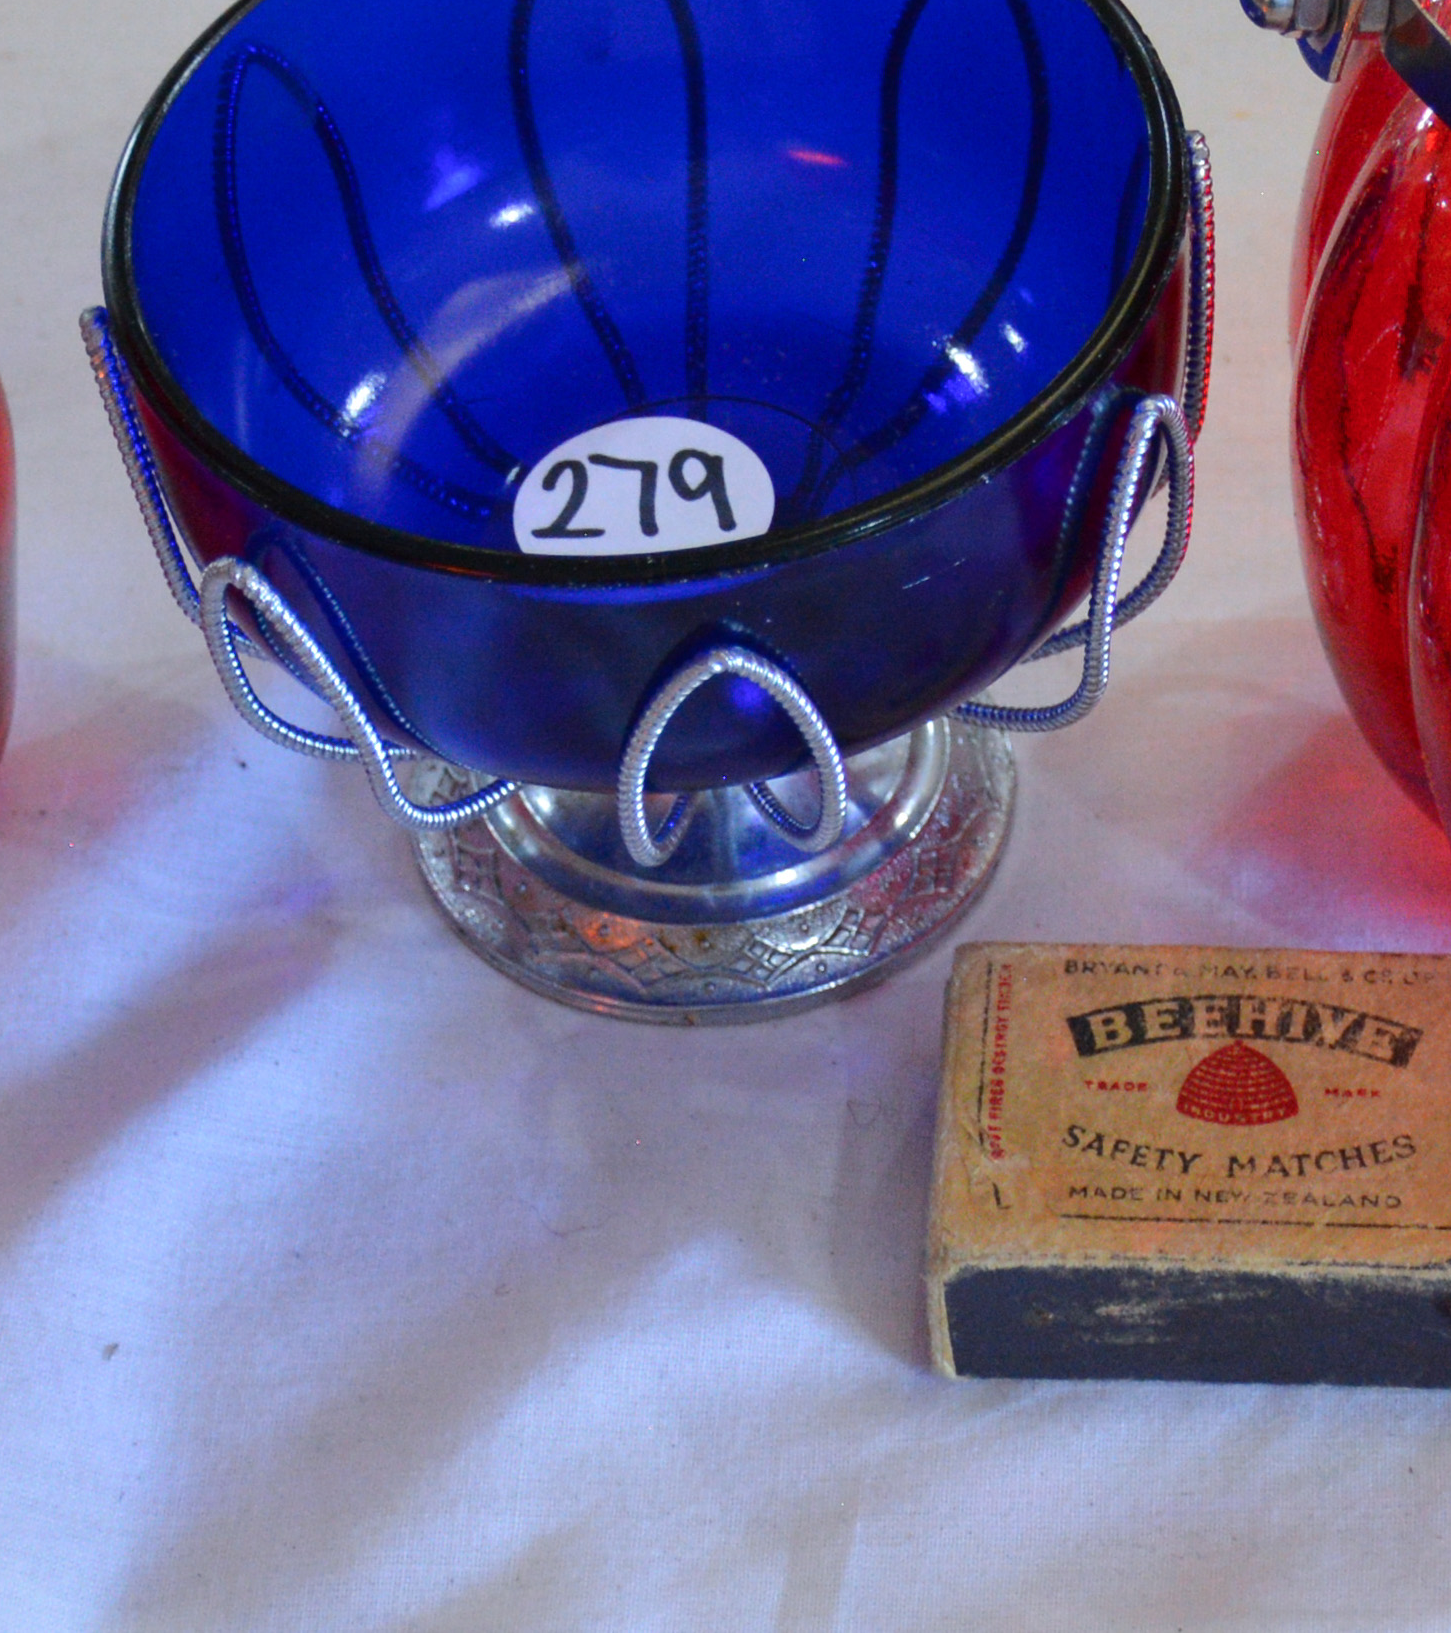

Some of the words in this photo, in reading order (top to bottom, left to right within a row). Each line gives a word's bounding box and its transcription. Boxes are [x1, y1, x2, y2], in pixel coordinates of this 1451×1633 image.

[531, 448, 737, 538] 279
[1084, 997, 1406, 1064] BEEHIVE
[1084, 1079, 1149, 1093] TRADE
[1061, 1123, 1203, 1175] SAFETY
[1226, 1133, 1418, 1179] MATCHES
[1068, 1185, 1145, 1202] MADE
[1156, 1187, 1183, 1203] IN
[1262, 1190, 1403, 1210] ZEALAND
